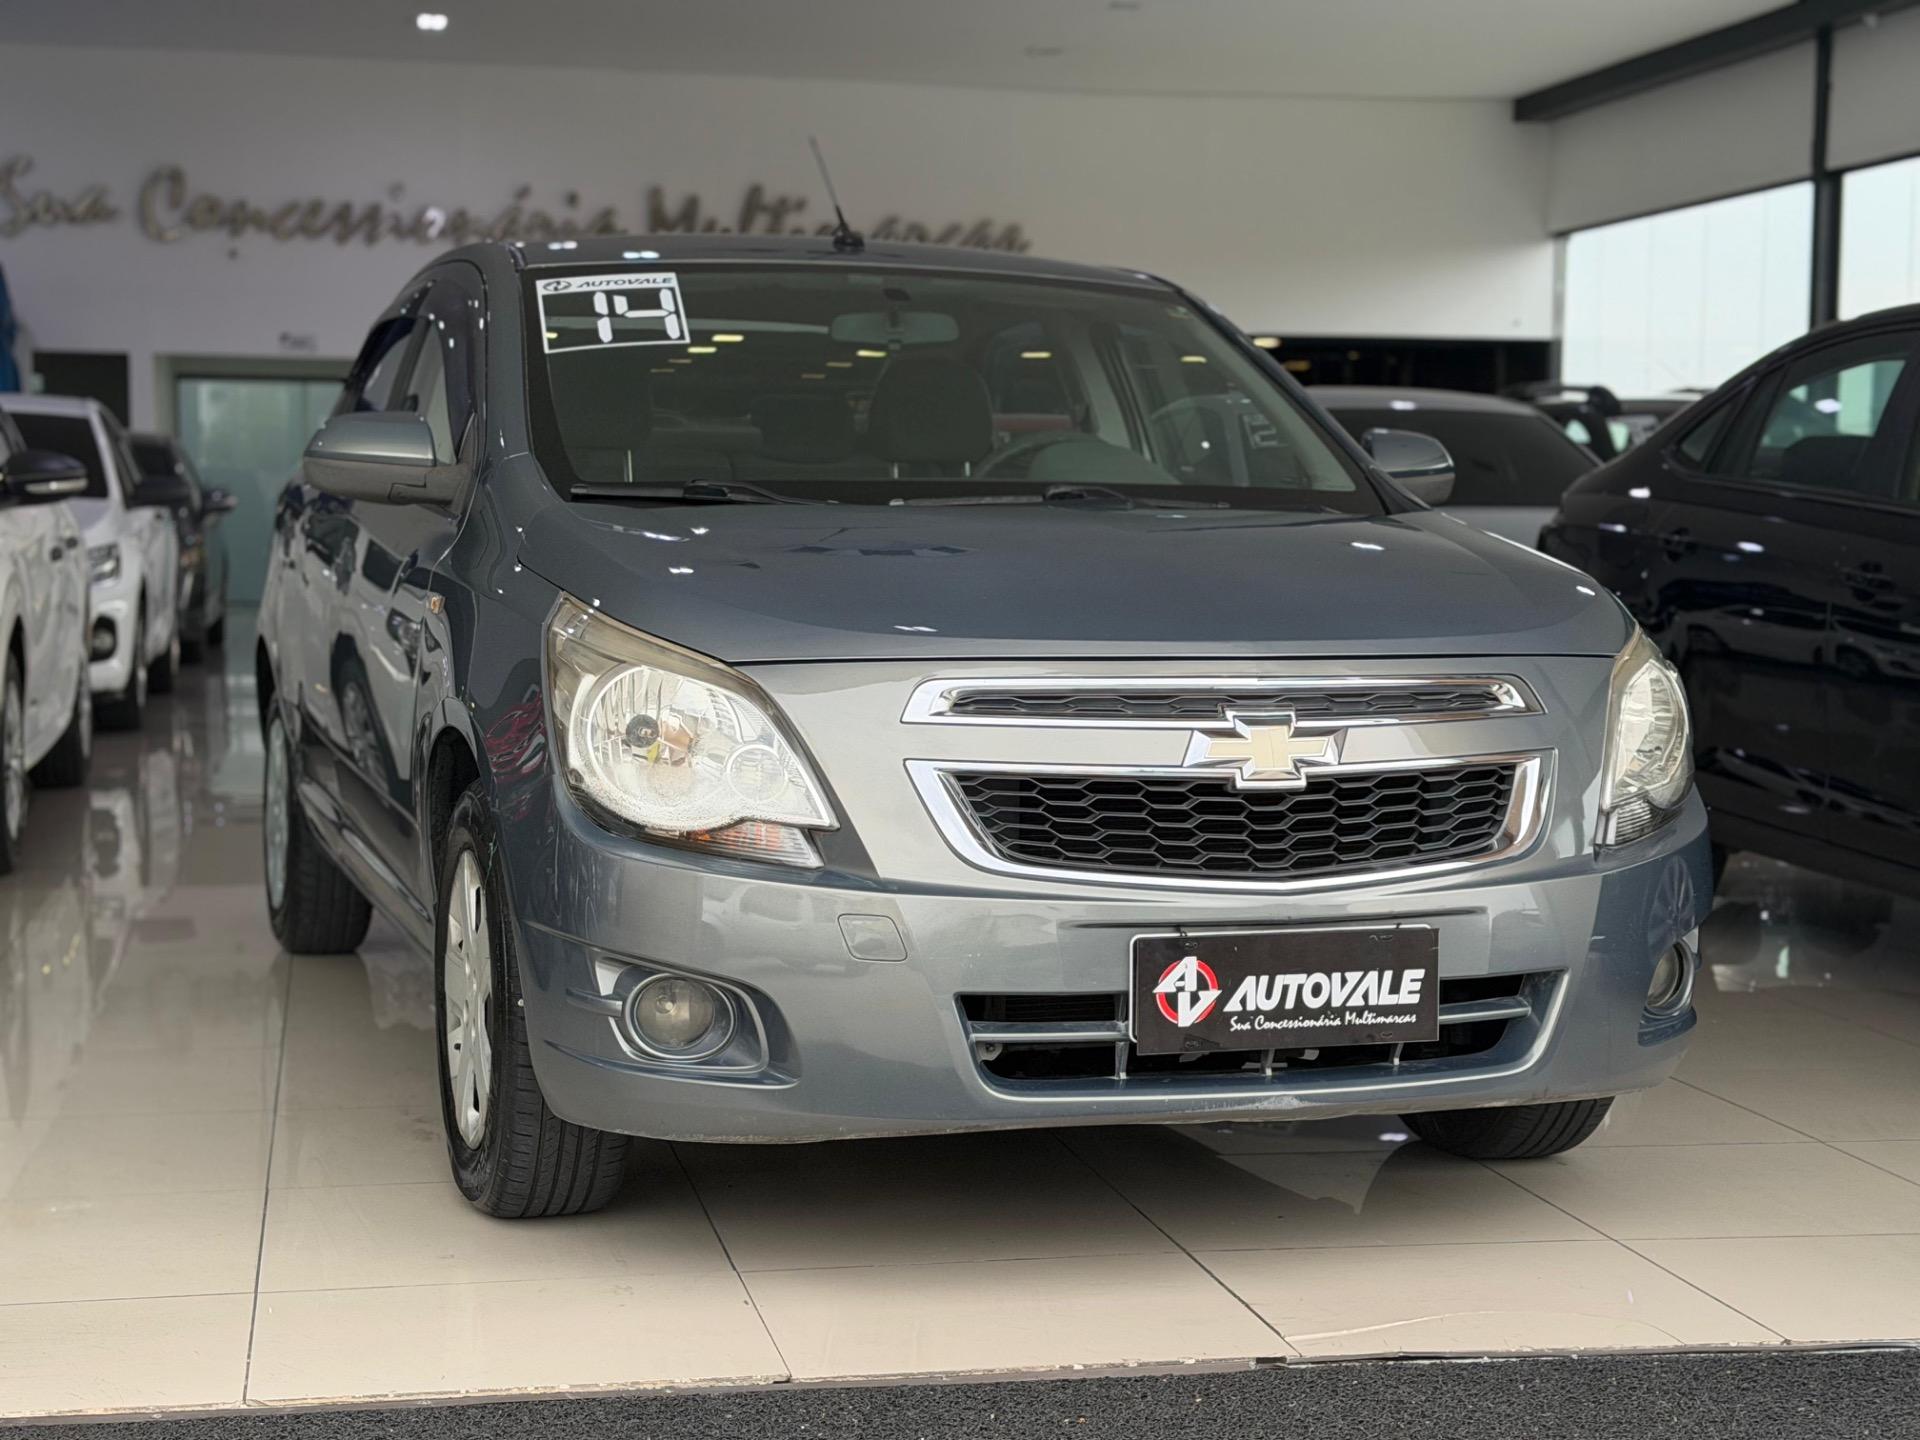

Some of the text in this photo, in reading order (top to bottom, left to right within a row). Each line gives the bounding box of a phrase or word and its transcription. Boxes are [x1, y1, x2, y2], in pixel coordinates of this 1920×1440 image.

[576, 277, 673, 289] AUTOVALE
[593, 288, 681, 343] 14
[1223, 968, 1426, 1012] AUTOVALE
[1229, 1010, 1417, 1032] Sua Concessionária Multimarcas
